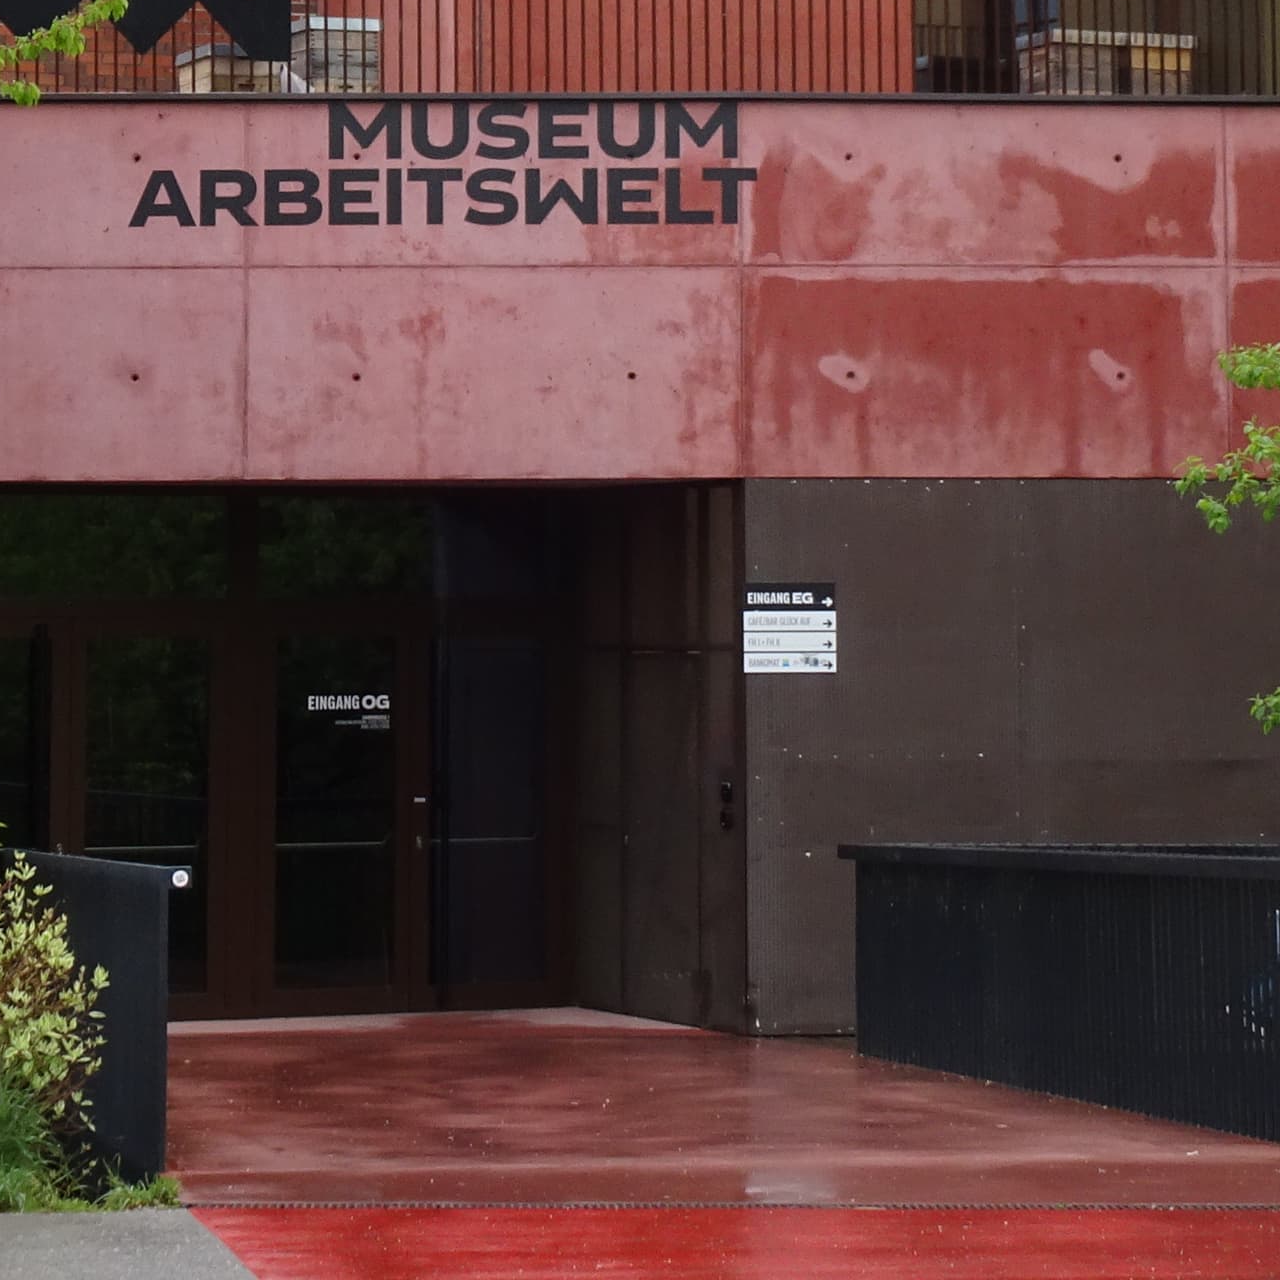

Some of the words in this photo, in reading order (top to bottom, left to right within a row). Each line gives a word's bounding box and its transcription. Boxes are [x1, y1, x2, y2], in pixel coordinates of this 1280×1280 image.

[328, 102, 738, 160] MUSEUM
[128, 168, 757, 227] ARBEITSWELT
[747, 592, 790, 604] EINGANG
[792, 592, 814, 604] EG
[308, 695, 360, 710] EINGANG
[361, 695, 390, 709] OG
